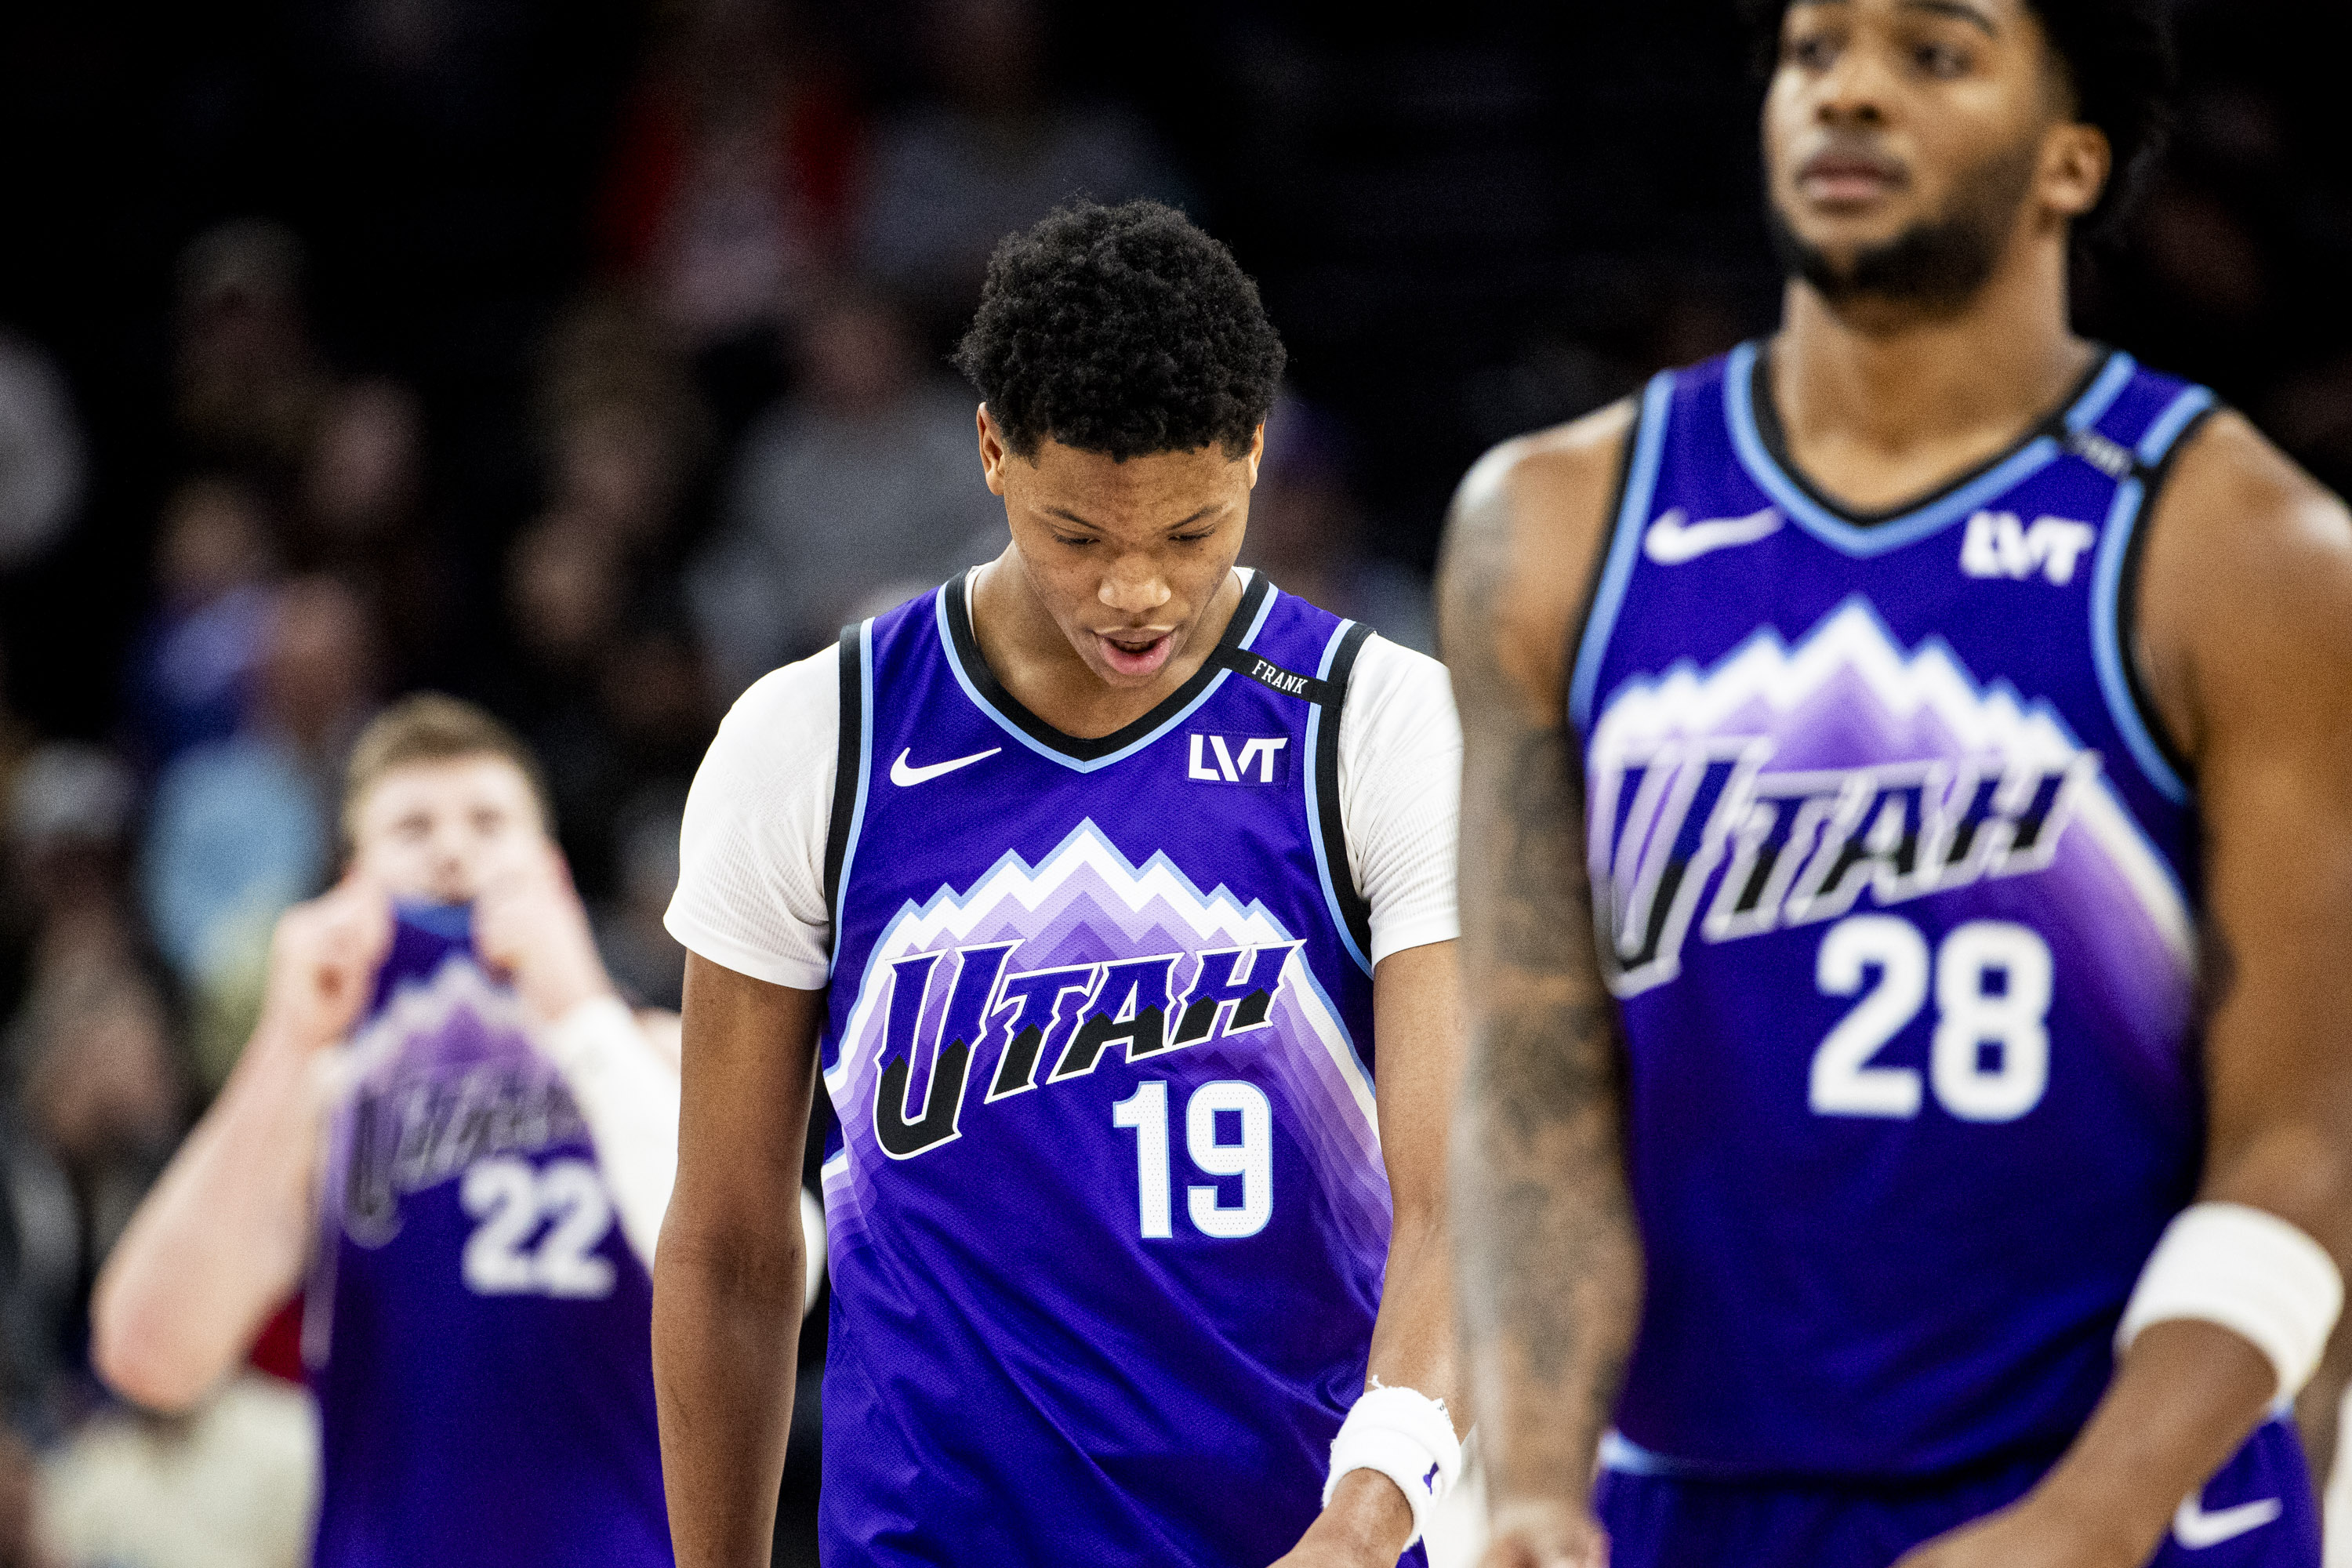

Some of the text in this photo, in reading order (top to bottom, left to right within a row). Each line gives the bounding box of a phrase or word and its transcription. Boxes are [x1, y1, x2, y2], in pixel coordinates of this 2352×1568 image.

[1960, 511, 2094, 585] LVT
[1252, 659, 1308, 694] FRANK
[1189, 734, 1288, 782] LVT
[1588, 735, 2103, 997] UTAH
[873, 939, 1307, 1161] UTAH
[1809, 914, 2053, 1121] 28
[461, 1157, 616, 1298] 22
[1112, 1080, 1272, 1240] 19
